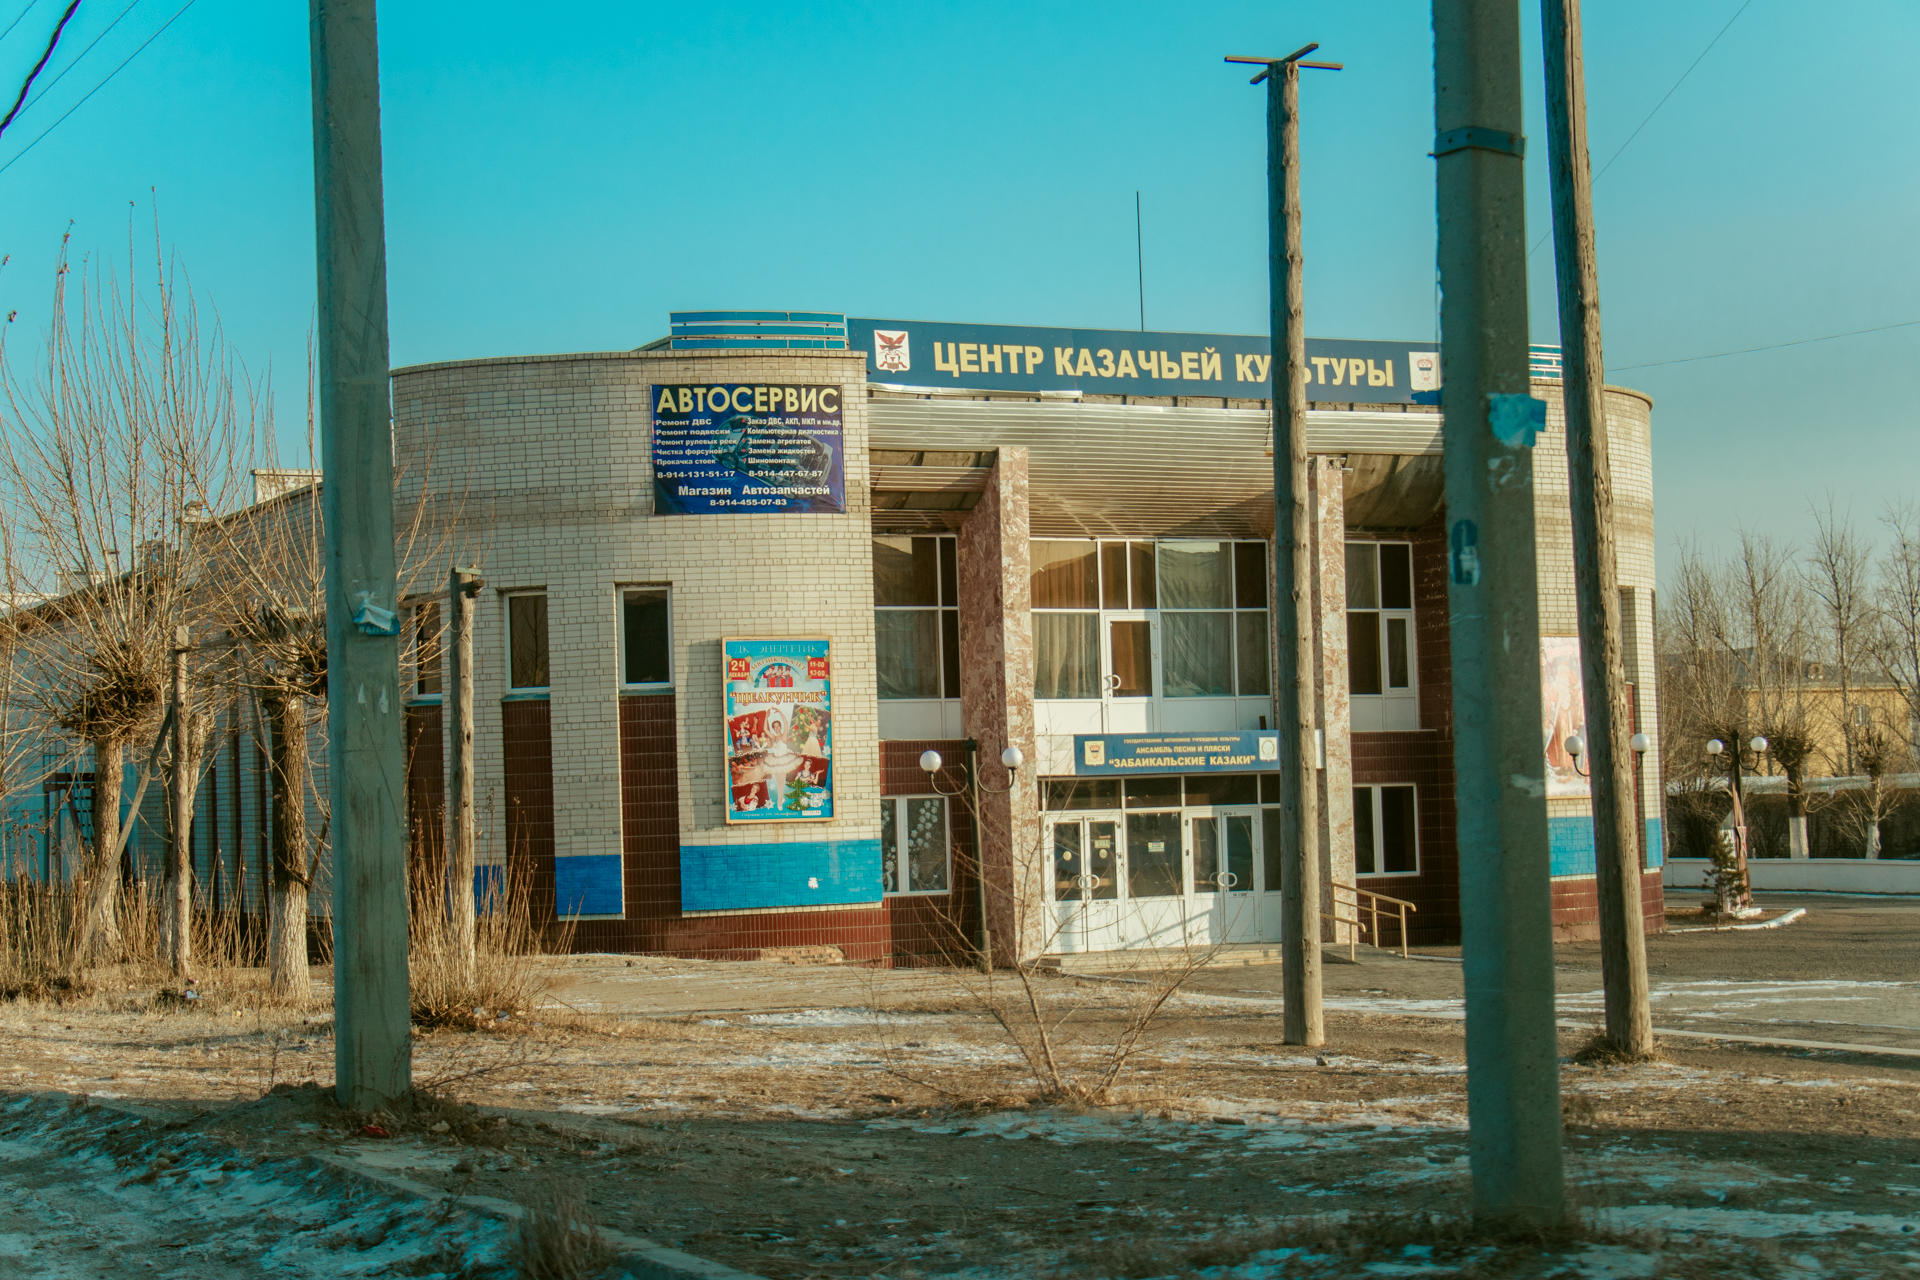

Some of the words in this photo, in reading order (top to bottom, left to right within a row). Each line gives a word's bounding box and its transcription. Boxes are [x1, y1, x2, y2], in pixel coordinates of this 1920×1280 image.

[933, 341, 1044, 377] ЦЕНТР
[1053, 346, 1222, 381] КАЗАЧЬЕЙ
[1235, 353, 1394, 387] КУТУРЫ
[656, 387, 839, 413] АВТОСЕРВИС
[692, 418, 712, 426] ДВС
[747, 428, 796, 436] Компьютерная
[657, 470, 735, 478] 8-914-131-51-17
[678, 486, 731, 496] Магазин
[742, 484, 830, 496] Автозапчастей
[731, 660, 745, 671] 24
[1136, 746, 1172, 754] АНСАМБЛЬ
